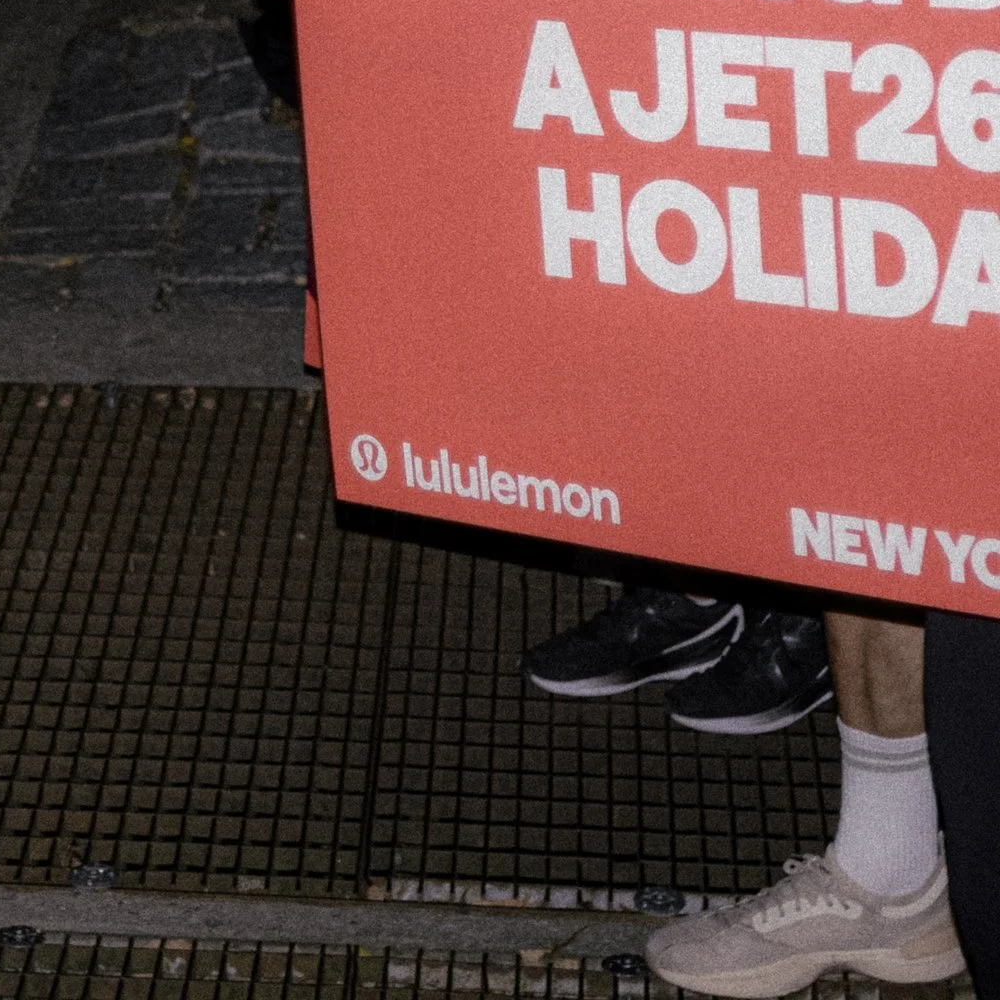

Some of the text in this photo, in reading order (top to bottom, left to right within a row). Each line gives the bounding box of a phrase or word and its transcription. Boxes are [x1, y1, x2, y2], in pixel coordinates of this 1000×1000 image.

[513, 20, 1000, 174] A JET26
[537, 166, 1000, 328] HOLIDA
[403, 441, 621, 525] lululemon
[790, 506, 928, 576] NEW
